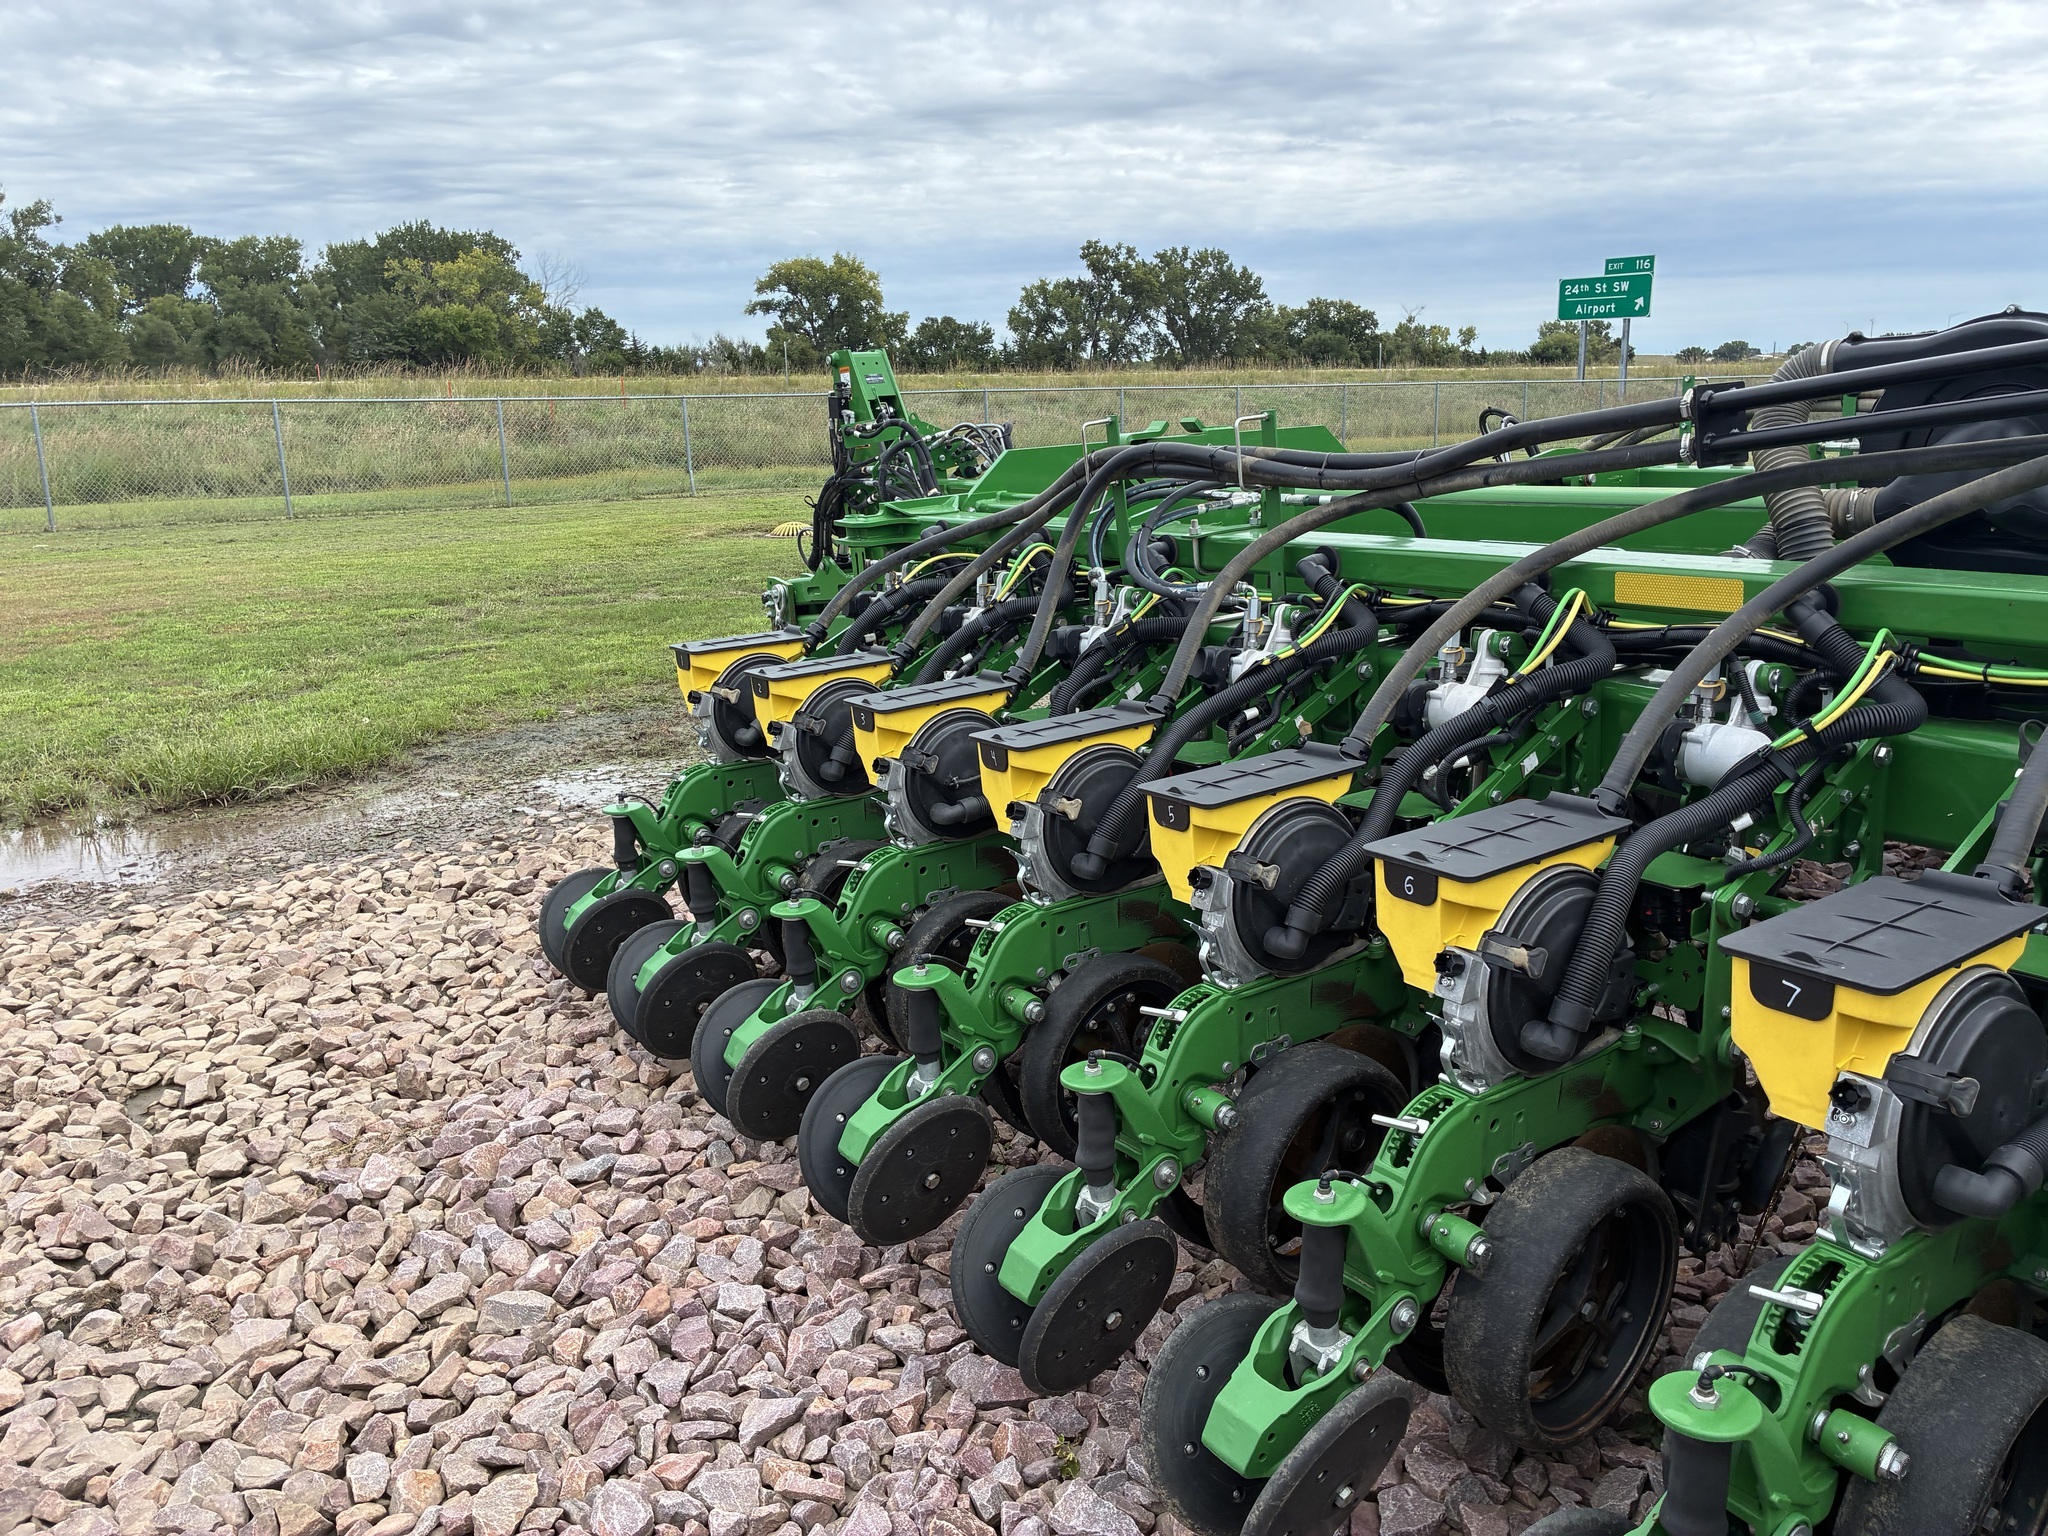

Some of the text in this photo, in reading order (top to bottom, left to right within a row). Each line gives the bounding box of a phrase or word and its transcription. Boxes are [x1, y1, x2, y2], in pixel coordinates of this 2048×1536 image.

[1608, 259, 1651, 270] EXIT 116
[1564, 281, 1630, 295] 24th St SW
[1575, 302, 1616, 316] Airport
[757, 682, 763, 694] 2
[860, 712, 866, 726] 3
[990, 750, 998, 767] 4
[1167, 805, 1175, 823] 5
[1404, 875, 1415, 896] 6
[1781, 979, 1802, 1008] 7
